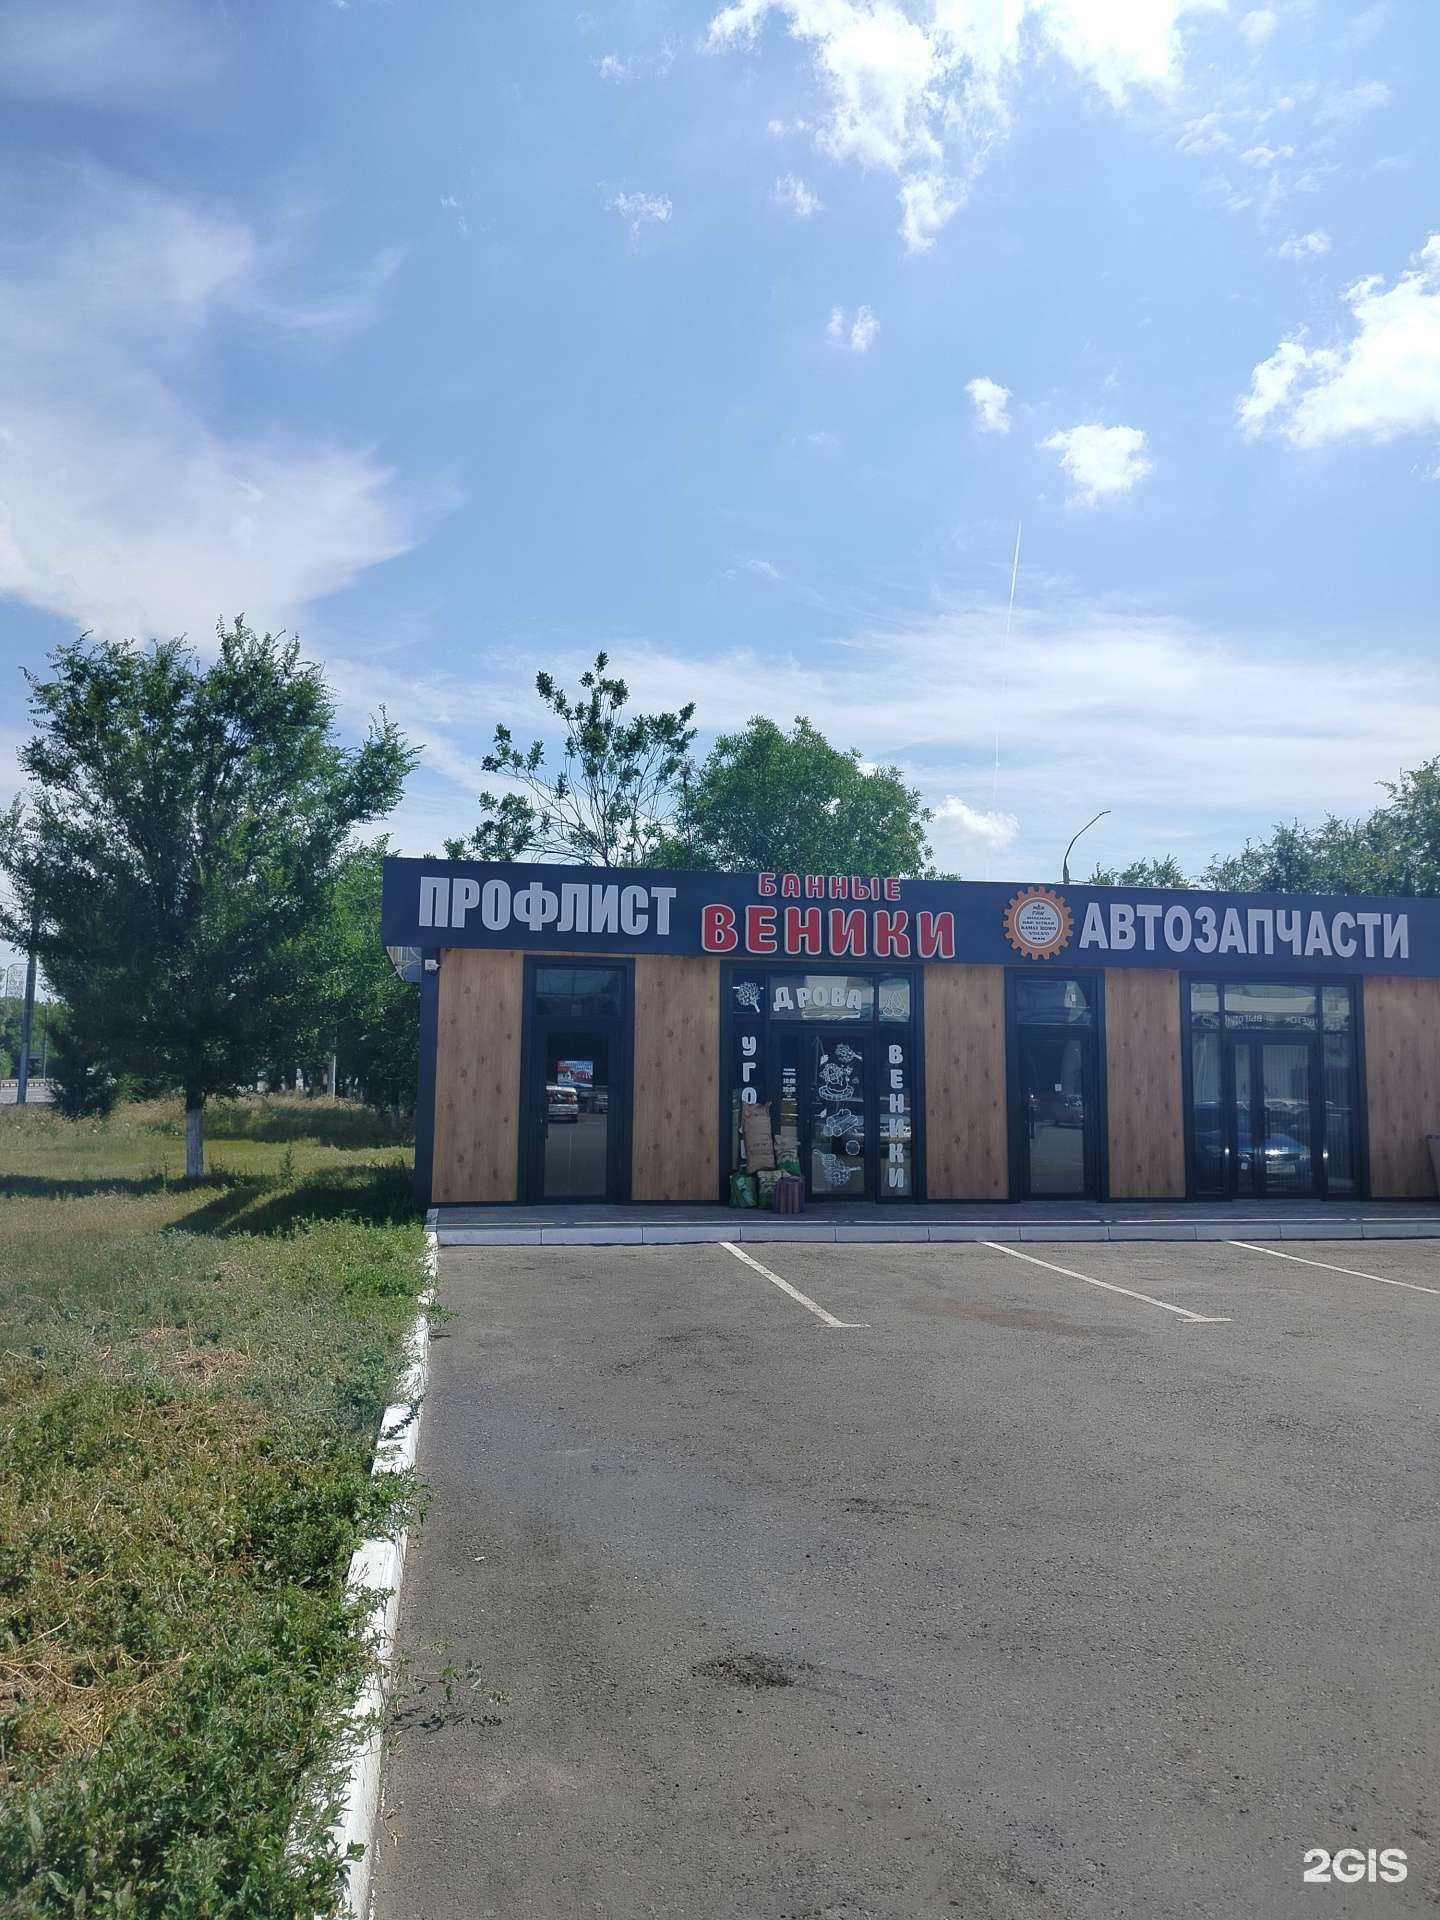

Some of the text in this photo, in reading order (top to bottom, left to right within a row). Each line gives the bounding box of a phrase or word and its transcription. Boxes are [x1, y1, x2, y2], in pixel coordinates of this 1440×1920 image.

[418, 876, 677, 935] ПРОФЛИСТ
[758, 872, 901, 901] БАННЫЕ
[702, 904, 956, 959] ВЕНИКИ
[1079, 902, 1409, 959] АВТОЗАПЧАСТИ
[773, 986, 862, 1012] ДРОВА
[888, 1044, 905, 1188] ВЕНИКИ
